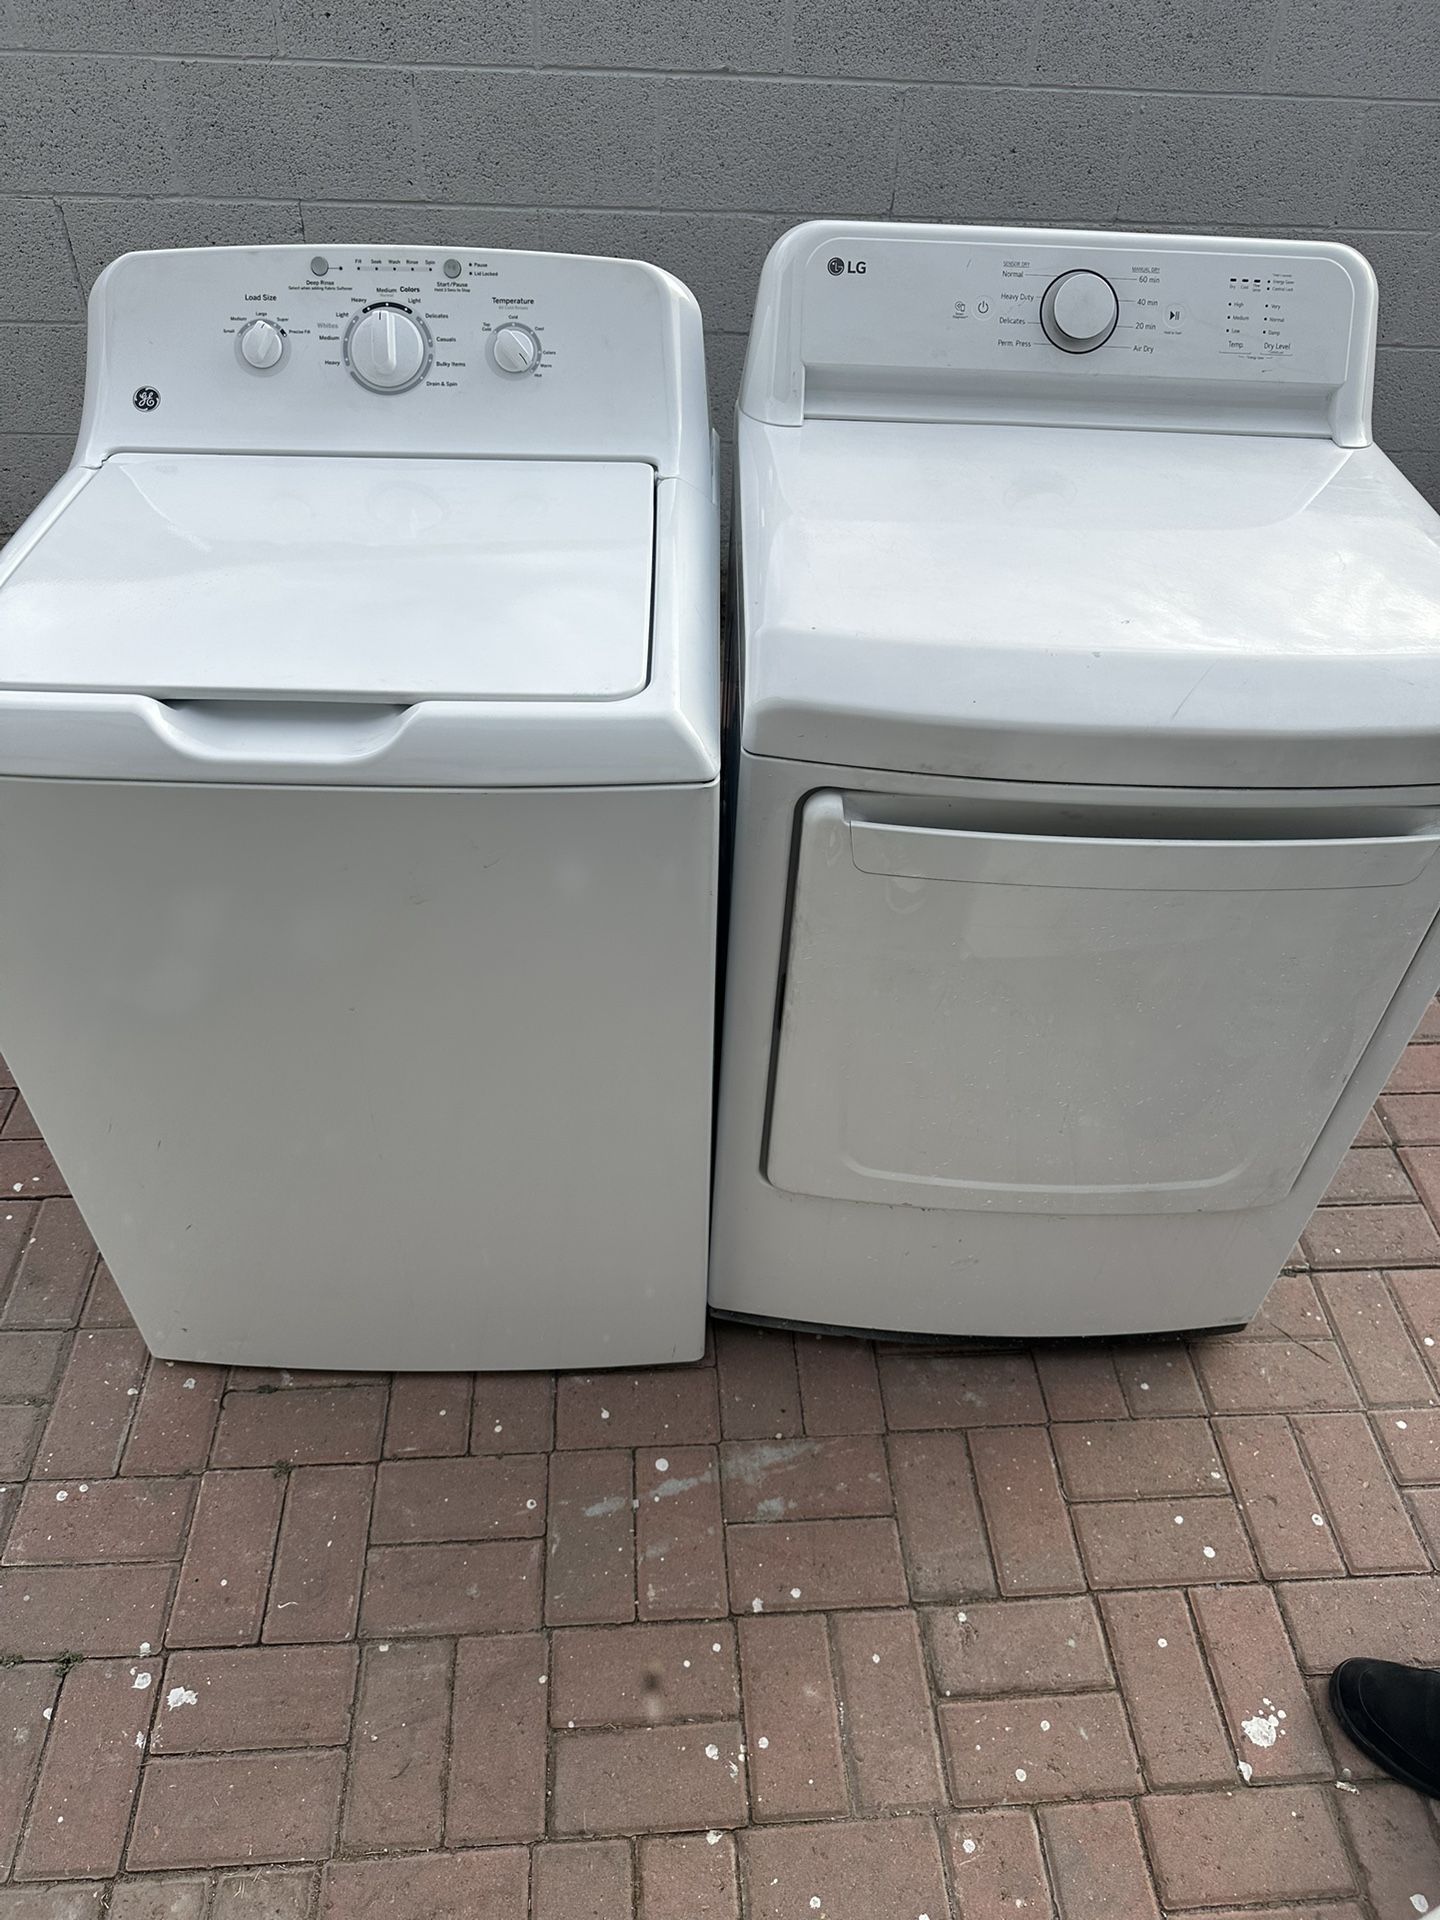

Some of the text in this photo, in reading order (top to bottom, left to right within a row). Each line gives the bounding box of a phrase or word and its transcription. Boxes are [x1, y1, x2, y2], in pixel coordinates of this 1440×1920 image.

[848, 261, 866, 274] LG
[492, 297, 534, 305] Temperature
[1001, 293, 1034, 302] Heavy Duty
[1000, 317, 1026, 325] Delicates
[1136, 322, 1144, 330] 20
[1144, 346, 1154, 354] Dry
[1264, 342, 1274, 352] Dry
